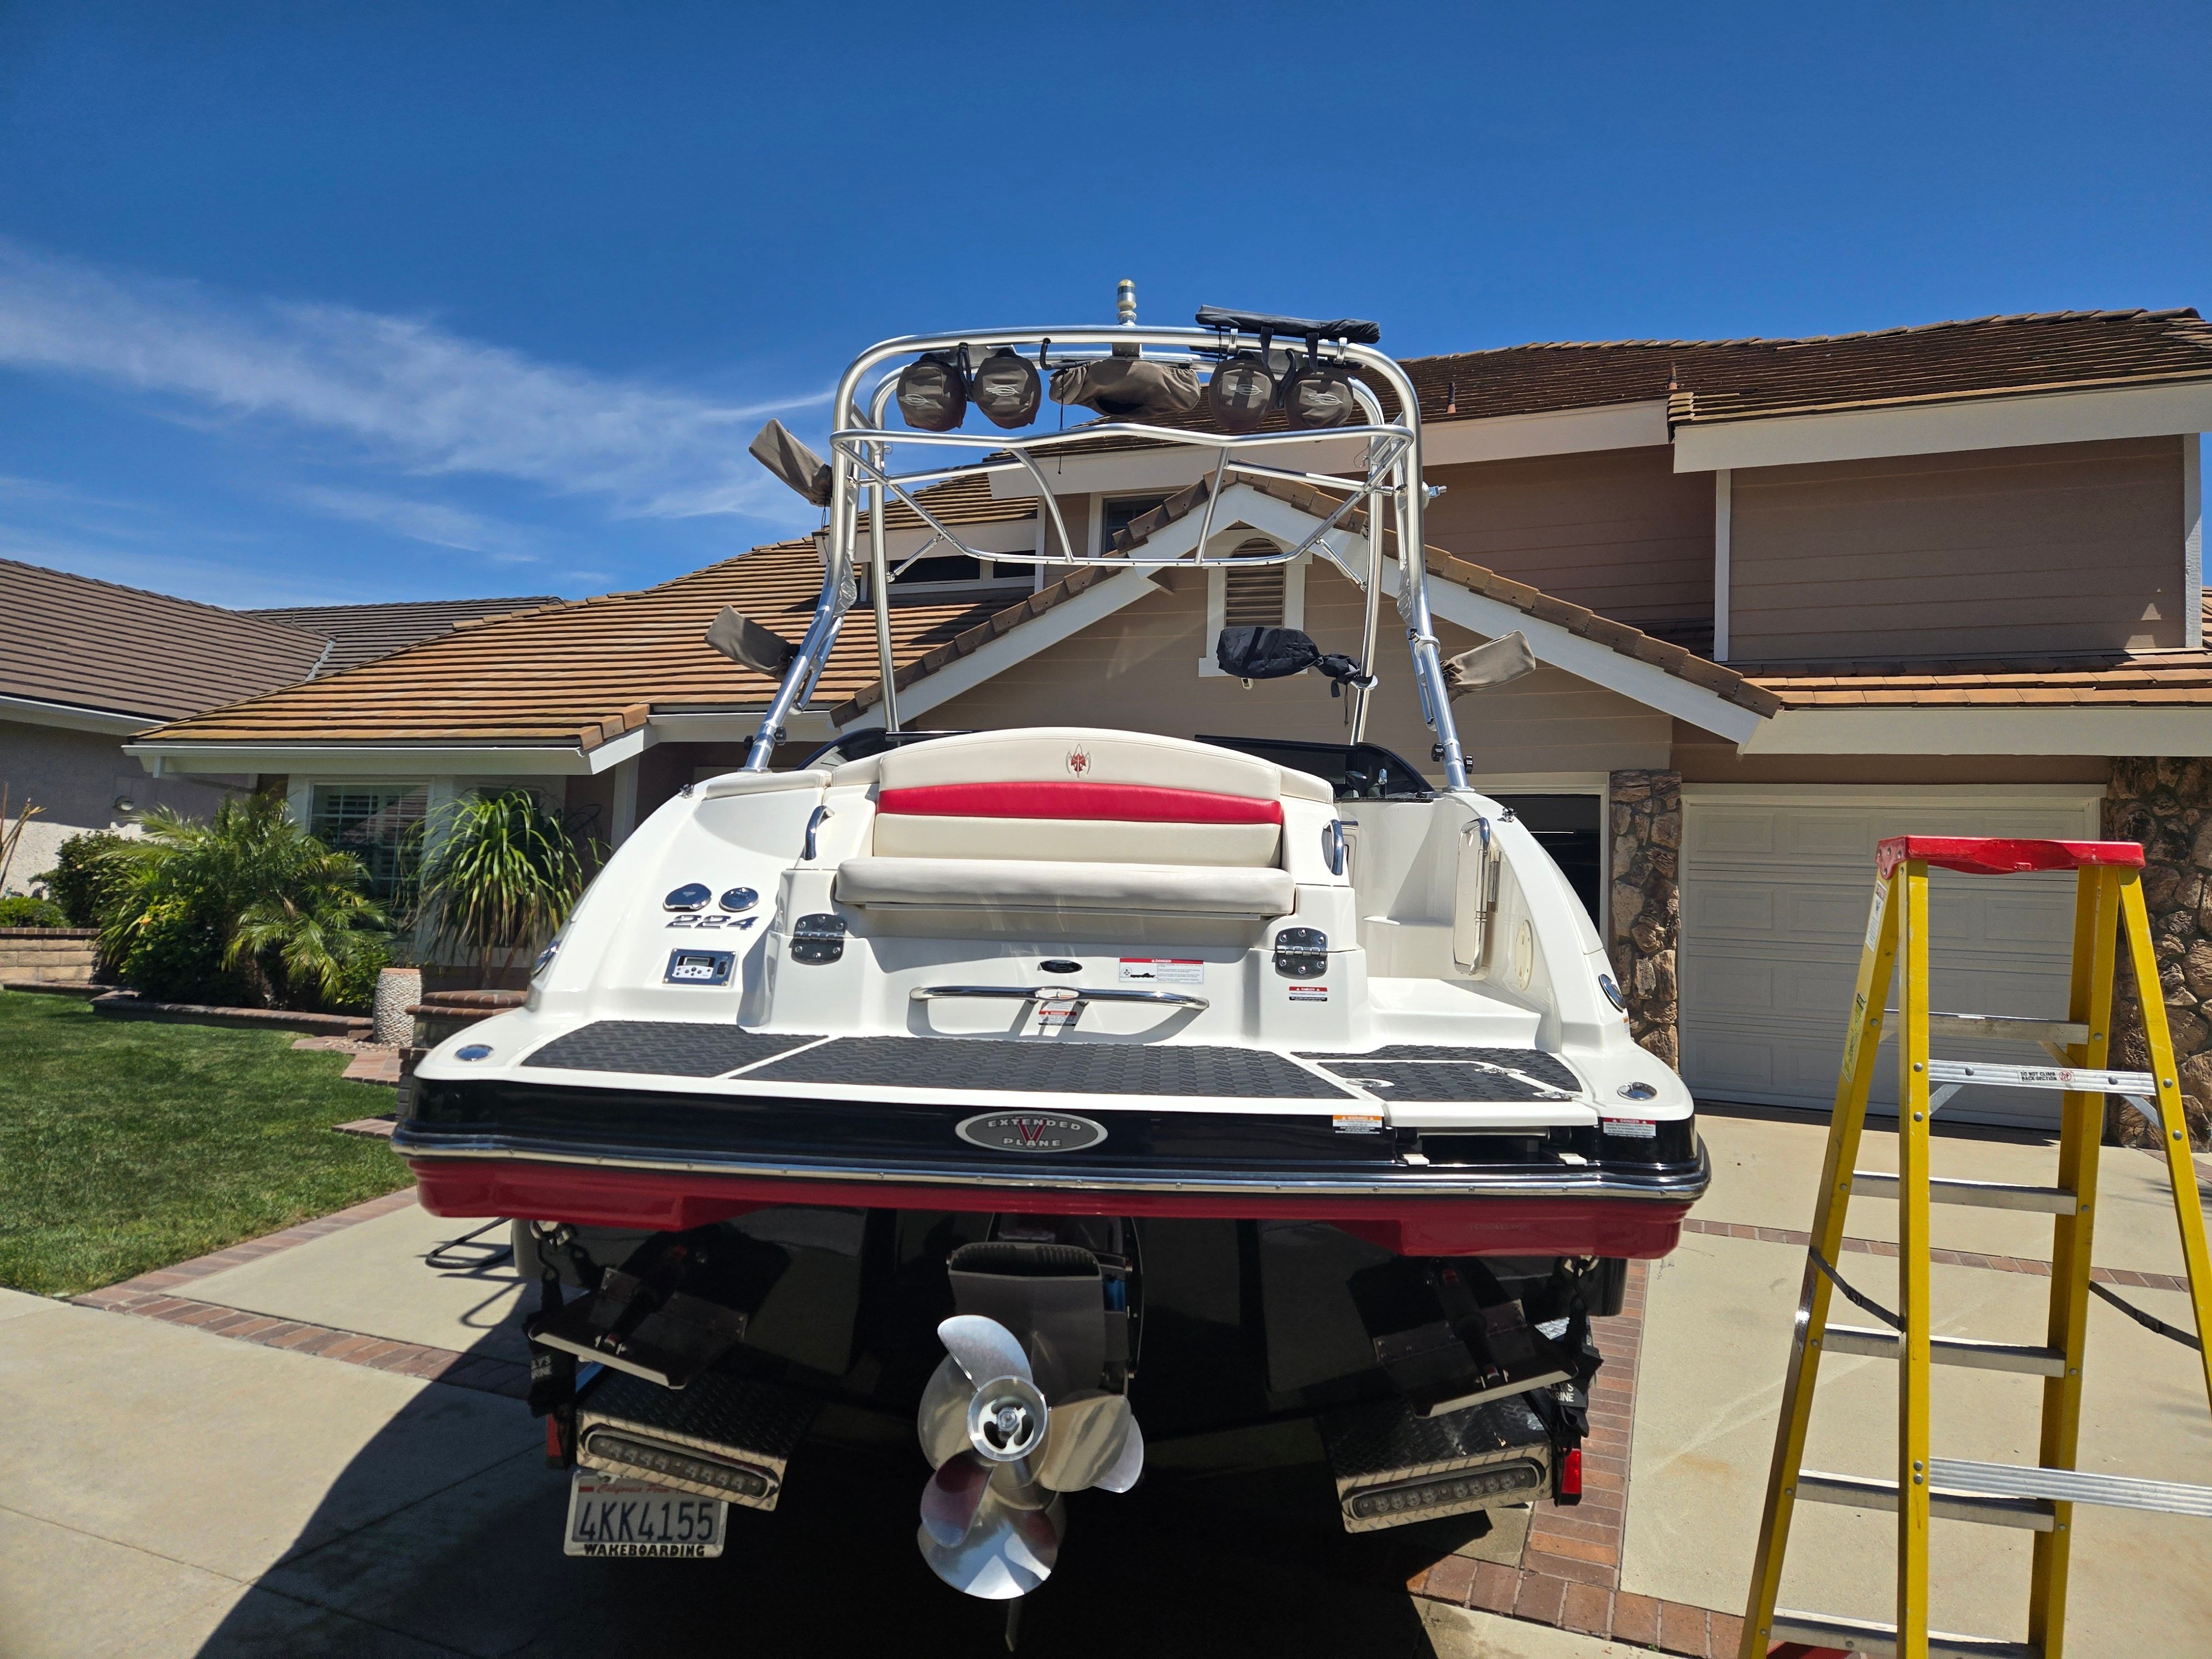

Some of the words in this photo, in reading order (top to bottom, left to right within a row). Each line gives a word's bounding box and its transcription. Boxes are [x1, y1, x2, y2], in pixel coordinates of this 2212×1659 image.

[665, 914, 760, 931] 224
[988, 1118, 1081, 1131] EXTENDED
[1003, 1138, 1061, 1146] PLANE
[579, 1501, 713, 1542] 4KK4155
[583, 1543, 705, 1557] WAKEBOARDING
